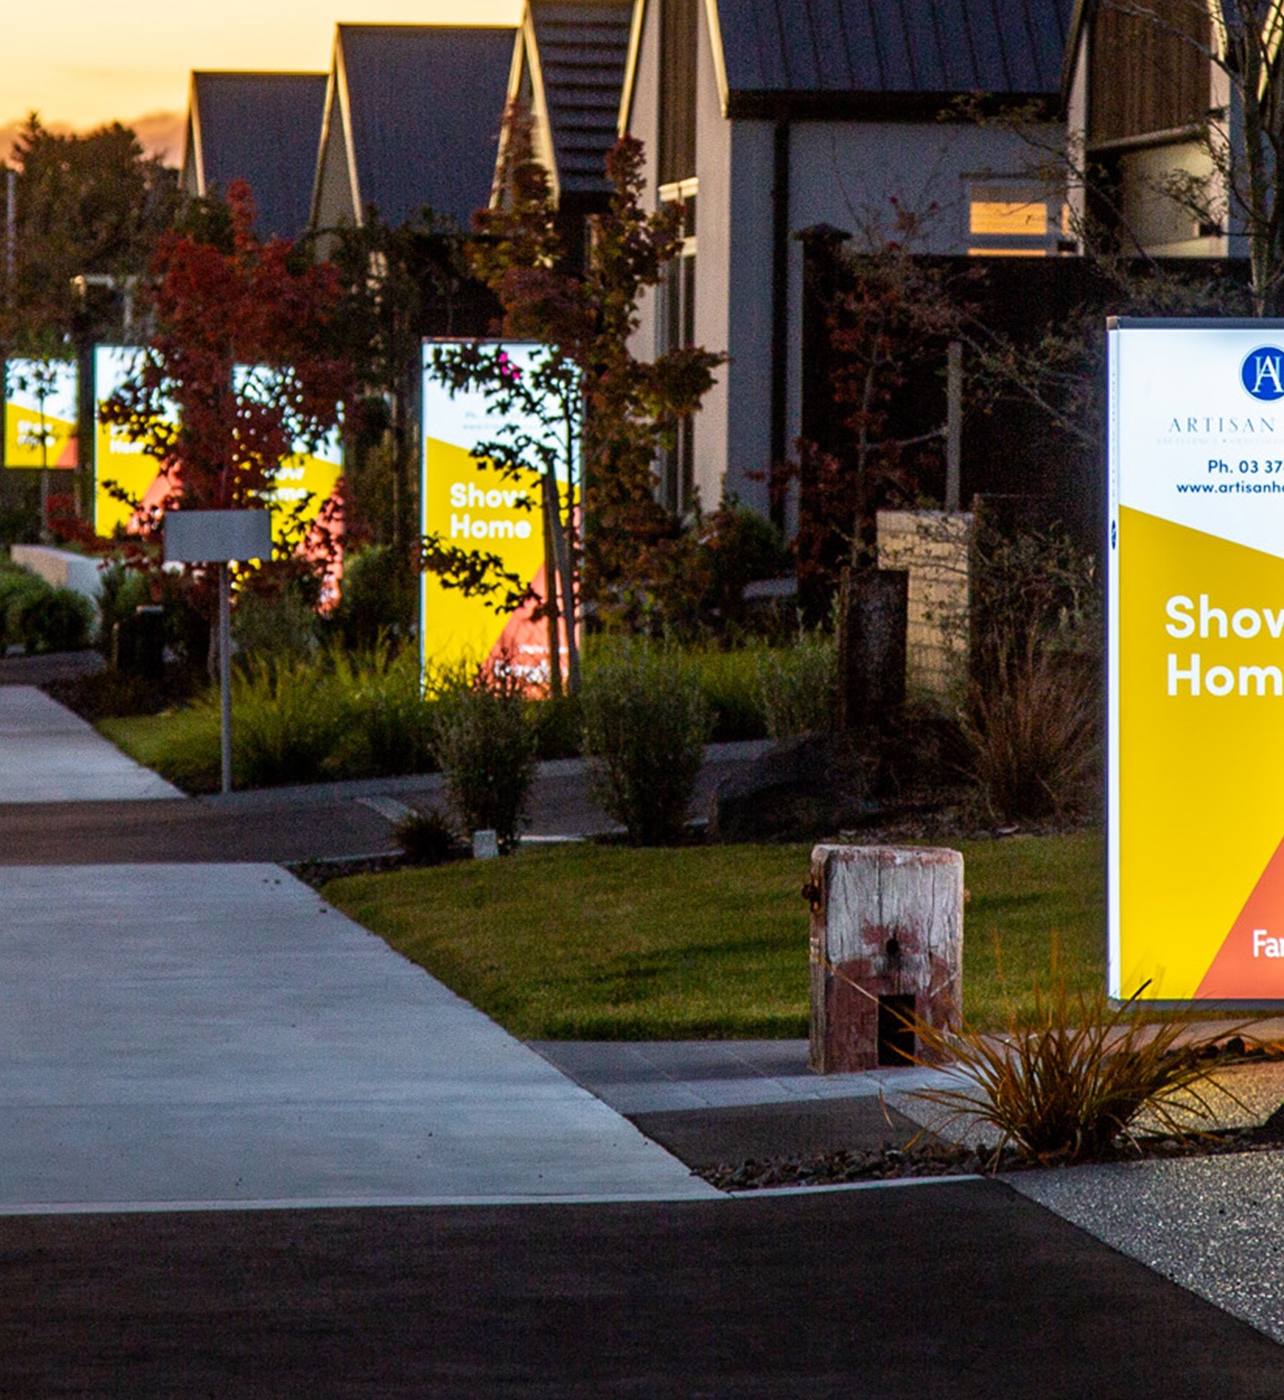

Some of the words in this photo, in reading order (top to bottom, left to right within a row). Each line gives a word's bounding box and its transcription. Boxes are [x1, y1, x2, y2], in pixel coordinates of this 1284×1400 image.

[1168, 417, 1275, 433] ARTISAN
[1208, 459, 1233, 474] Ph.
[1238, 460, 1259, 474] 03
[450, 513, 532, 539] Home
